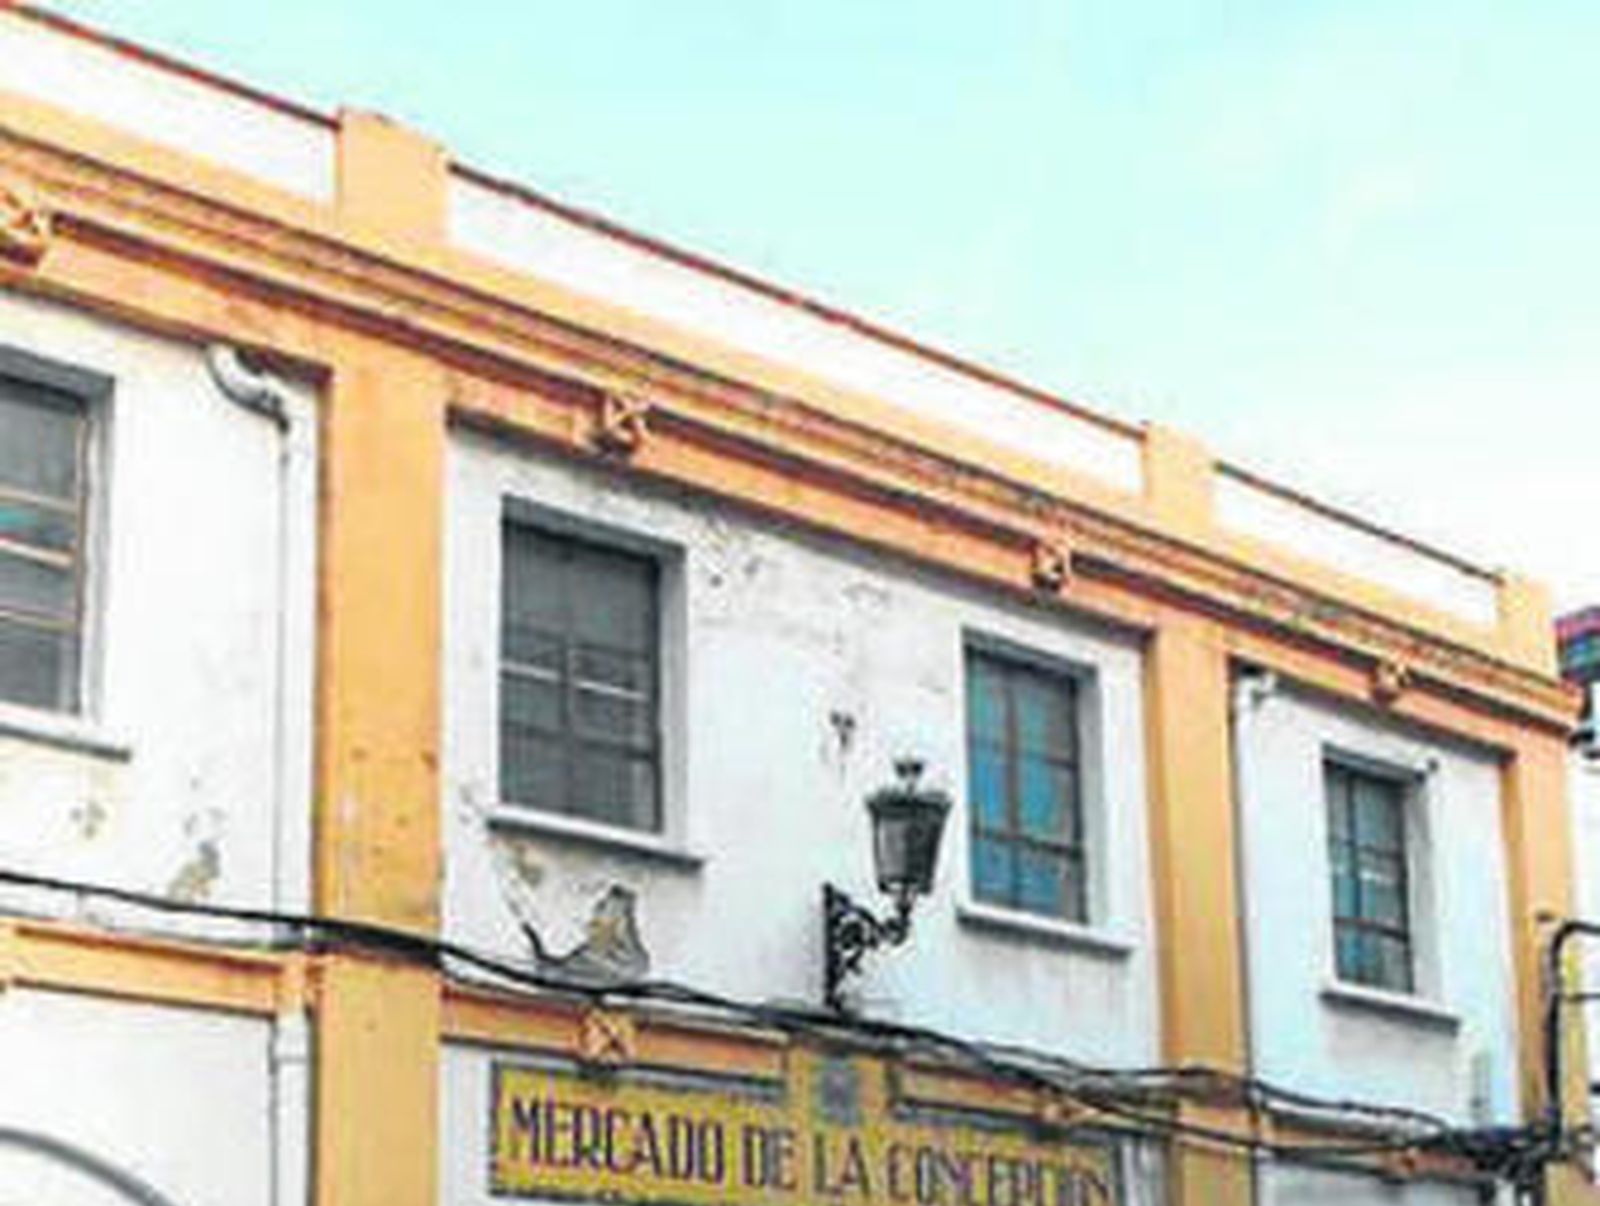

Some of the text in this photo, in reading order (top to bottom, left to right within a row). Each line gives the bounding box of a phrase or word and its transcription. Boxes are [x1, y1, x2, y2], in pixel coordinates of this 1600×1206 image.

[511, 1093, 724, 1186] MERCADO
[742, 1122, 797, 1190] DE
[812, 1132, 872, 1199] LA
